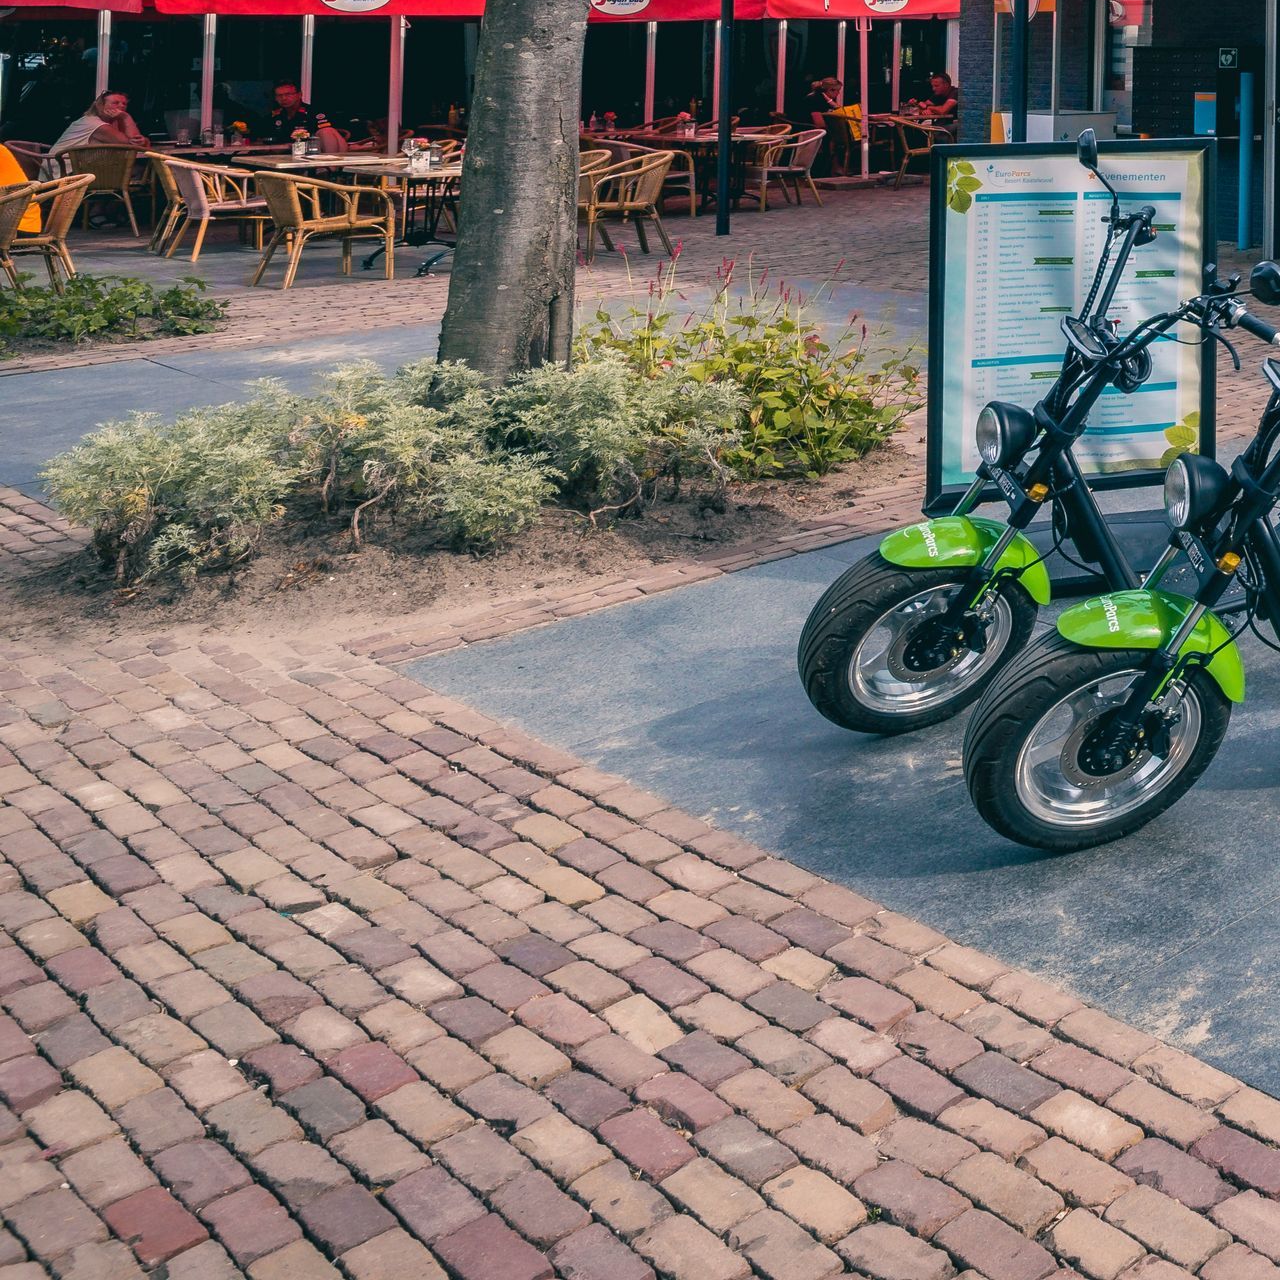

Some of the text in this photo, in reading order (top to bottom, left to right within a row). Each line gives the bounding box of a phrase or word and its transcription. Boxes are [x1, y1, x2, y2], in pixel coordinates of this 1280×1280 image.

[995, 170, 1031, 178] EuroParcs
[1100, 171, 1165, 181] Evenementen
[917, 521, 939, 557] EuroParcs
[1099, 594, 1120, 633] EuroParcs
